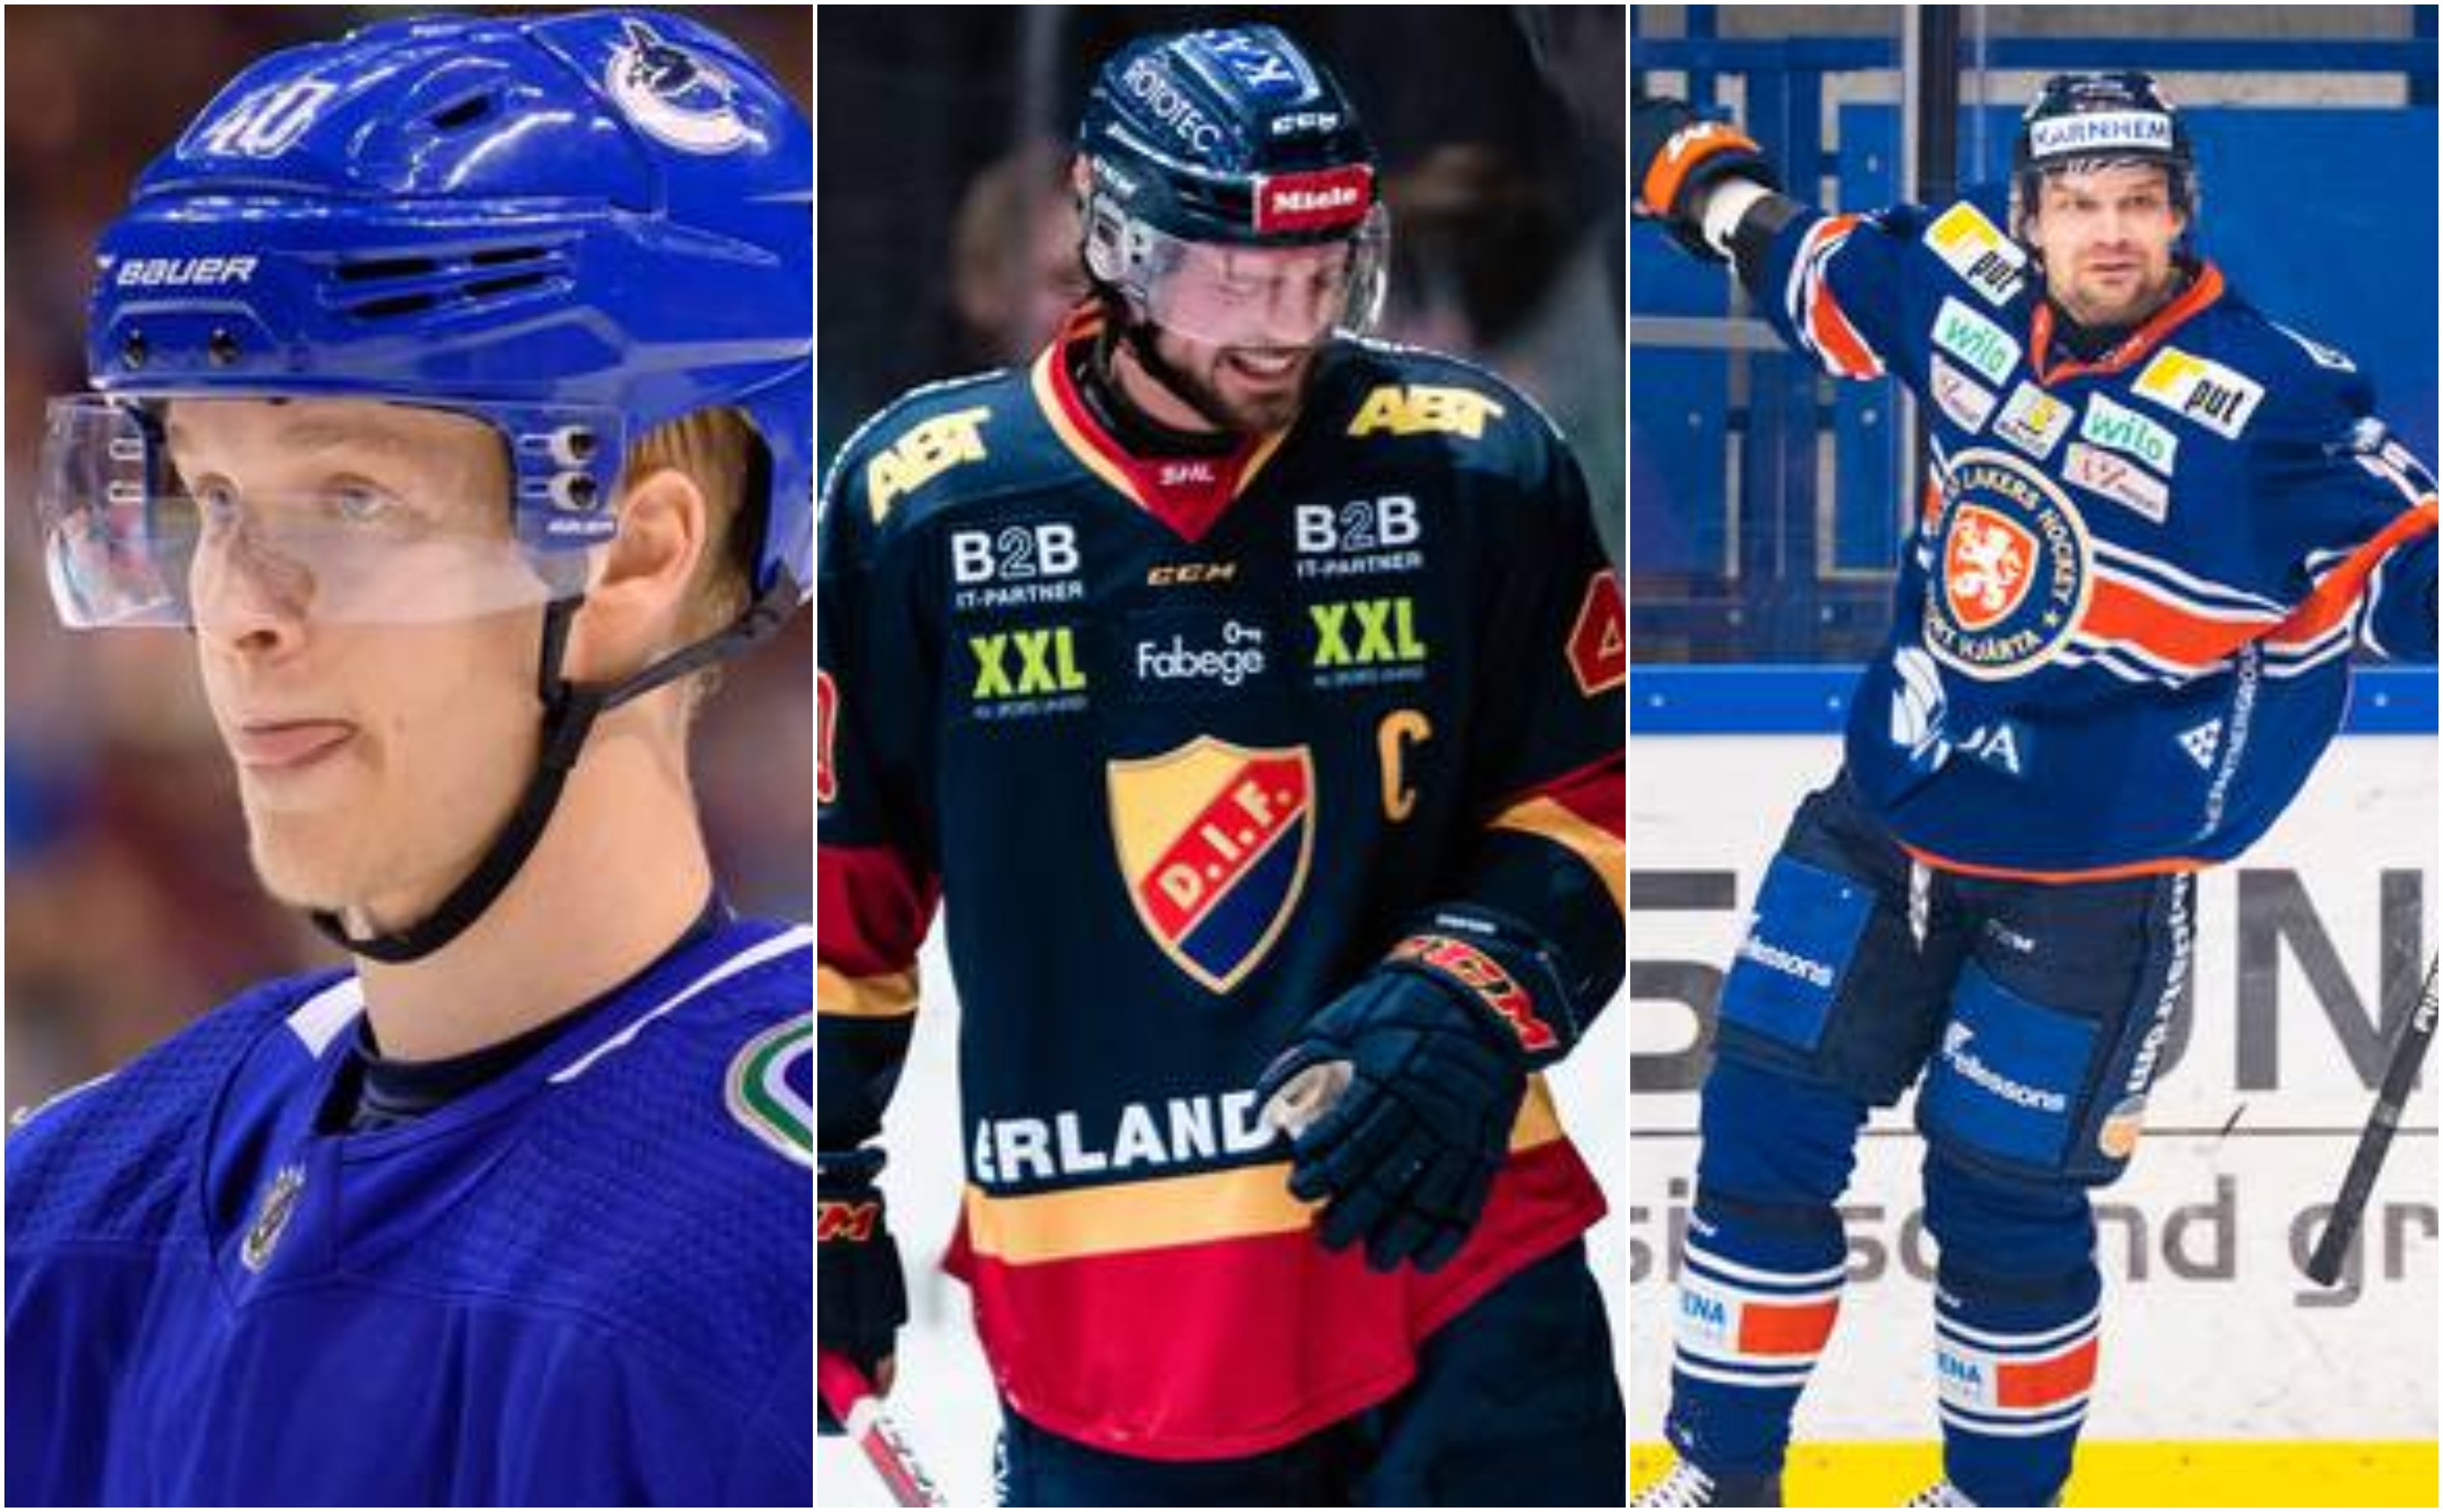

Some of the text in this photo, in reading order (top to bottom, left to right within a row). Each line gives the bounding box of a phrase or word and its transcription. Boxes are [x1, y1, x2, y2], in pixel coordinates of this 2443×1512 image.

[1273, 187, 1358, 213] Miele
[1968, 250, 2024, 293] put
[1947, 317, 2006, 373] wilo
[2185, 379, 2244, 424] put
[2090, 411, 2165, 460] wilo
[1296, 495, 1421, 553] B2B
[951, 522, 1080, 583] B2B
[955, 579, 1083, 609] IT-PARTNER
[1310, 597, 1427, 667] XXL
[969, 627, 1086, 698] XXL
[1137, 635, 1264, 686] Fabege
[1377, 709, 1431, 823] C
[1157, 780, 1292, 911] D.I.F.
